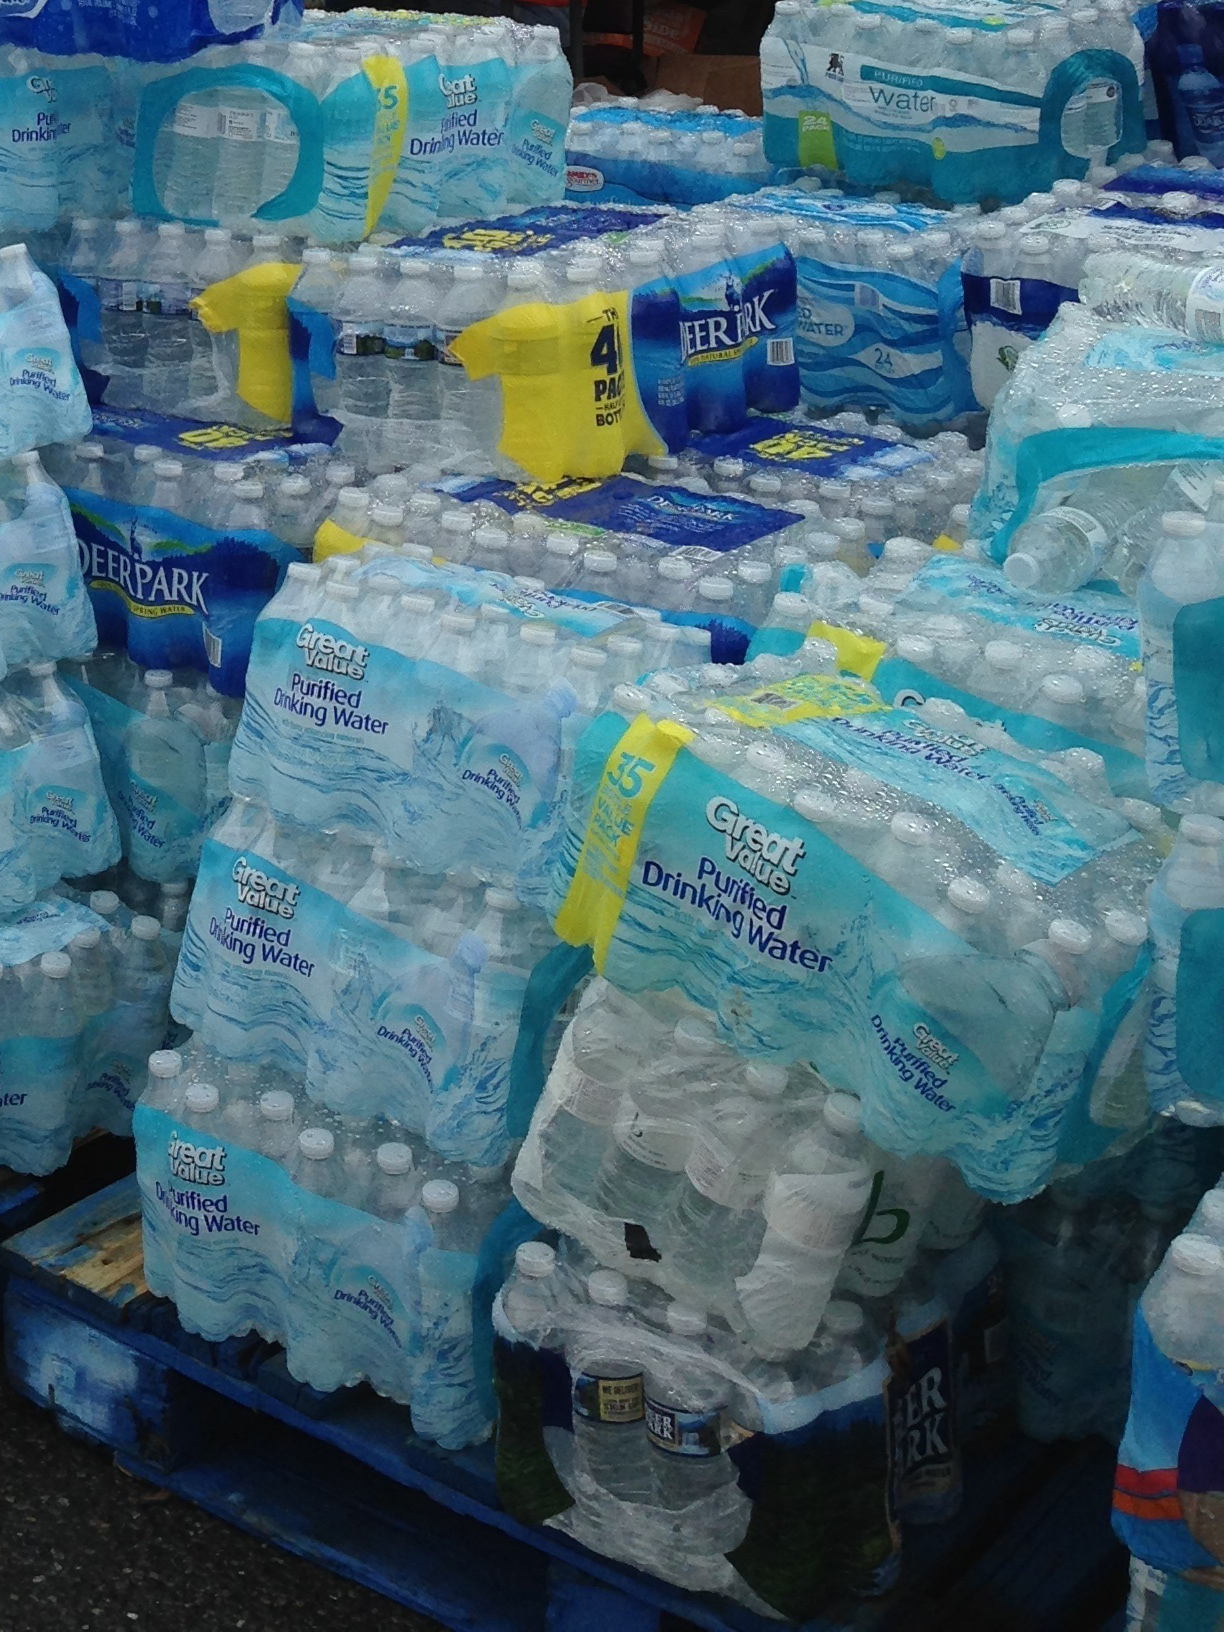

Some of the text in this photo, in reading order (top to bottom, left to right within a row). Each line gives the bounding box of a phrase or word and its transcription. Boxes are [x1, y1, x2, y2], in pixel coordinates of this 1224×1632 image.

[873, 70, 924, 87] PURIFIED
[458, 127, 505, 147] Water
[802, 114, 829, 125] 24
[134, 562, 210, 616] PARK
[295, 622, 370, 668] Great
[304, 647, 367, 681] Value
[274, 687, 389, 735] Drinking Water
[291, 672, 362, 710] Purified
[462, 769, 505, 802] Drinking
[606, 751, 656, 799] 35
[705, 795, 806, 877] Great
[231, 855, 301, 908] Great
[724, 833, 791, 896] Value
[237, 882, 295, 920] Value
[697, 856, 788, 931] Purified
[225, 905, 292, 948] Purified
[641, 860, 745, 939] Drinking
[748, 917, 834, 973] Water
[261, 942, 315, 978] Water
[376, 1024, 418, 1059] Drinking
[871, 1014, 957, 1112] Drinking Water
[893, 1037, 948, 1089] Purified
[912, 1021, 960, 1067] Great
[203, 1212, 261, 1237] Water
[333, 1288, 379, 1321] Drinking
